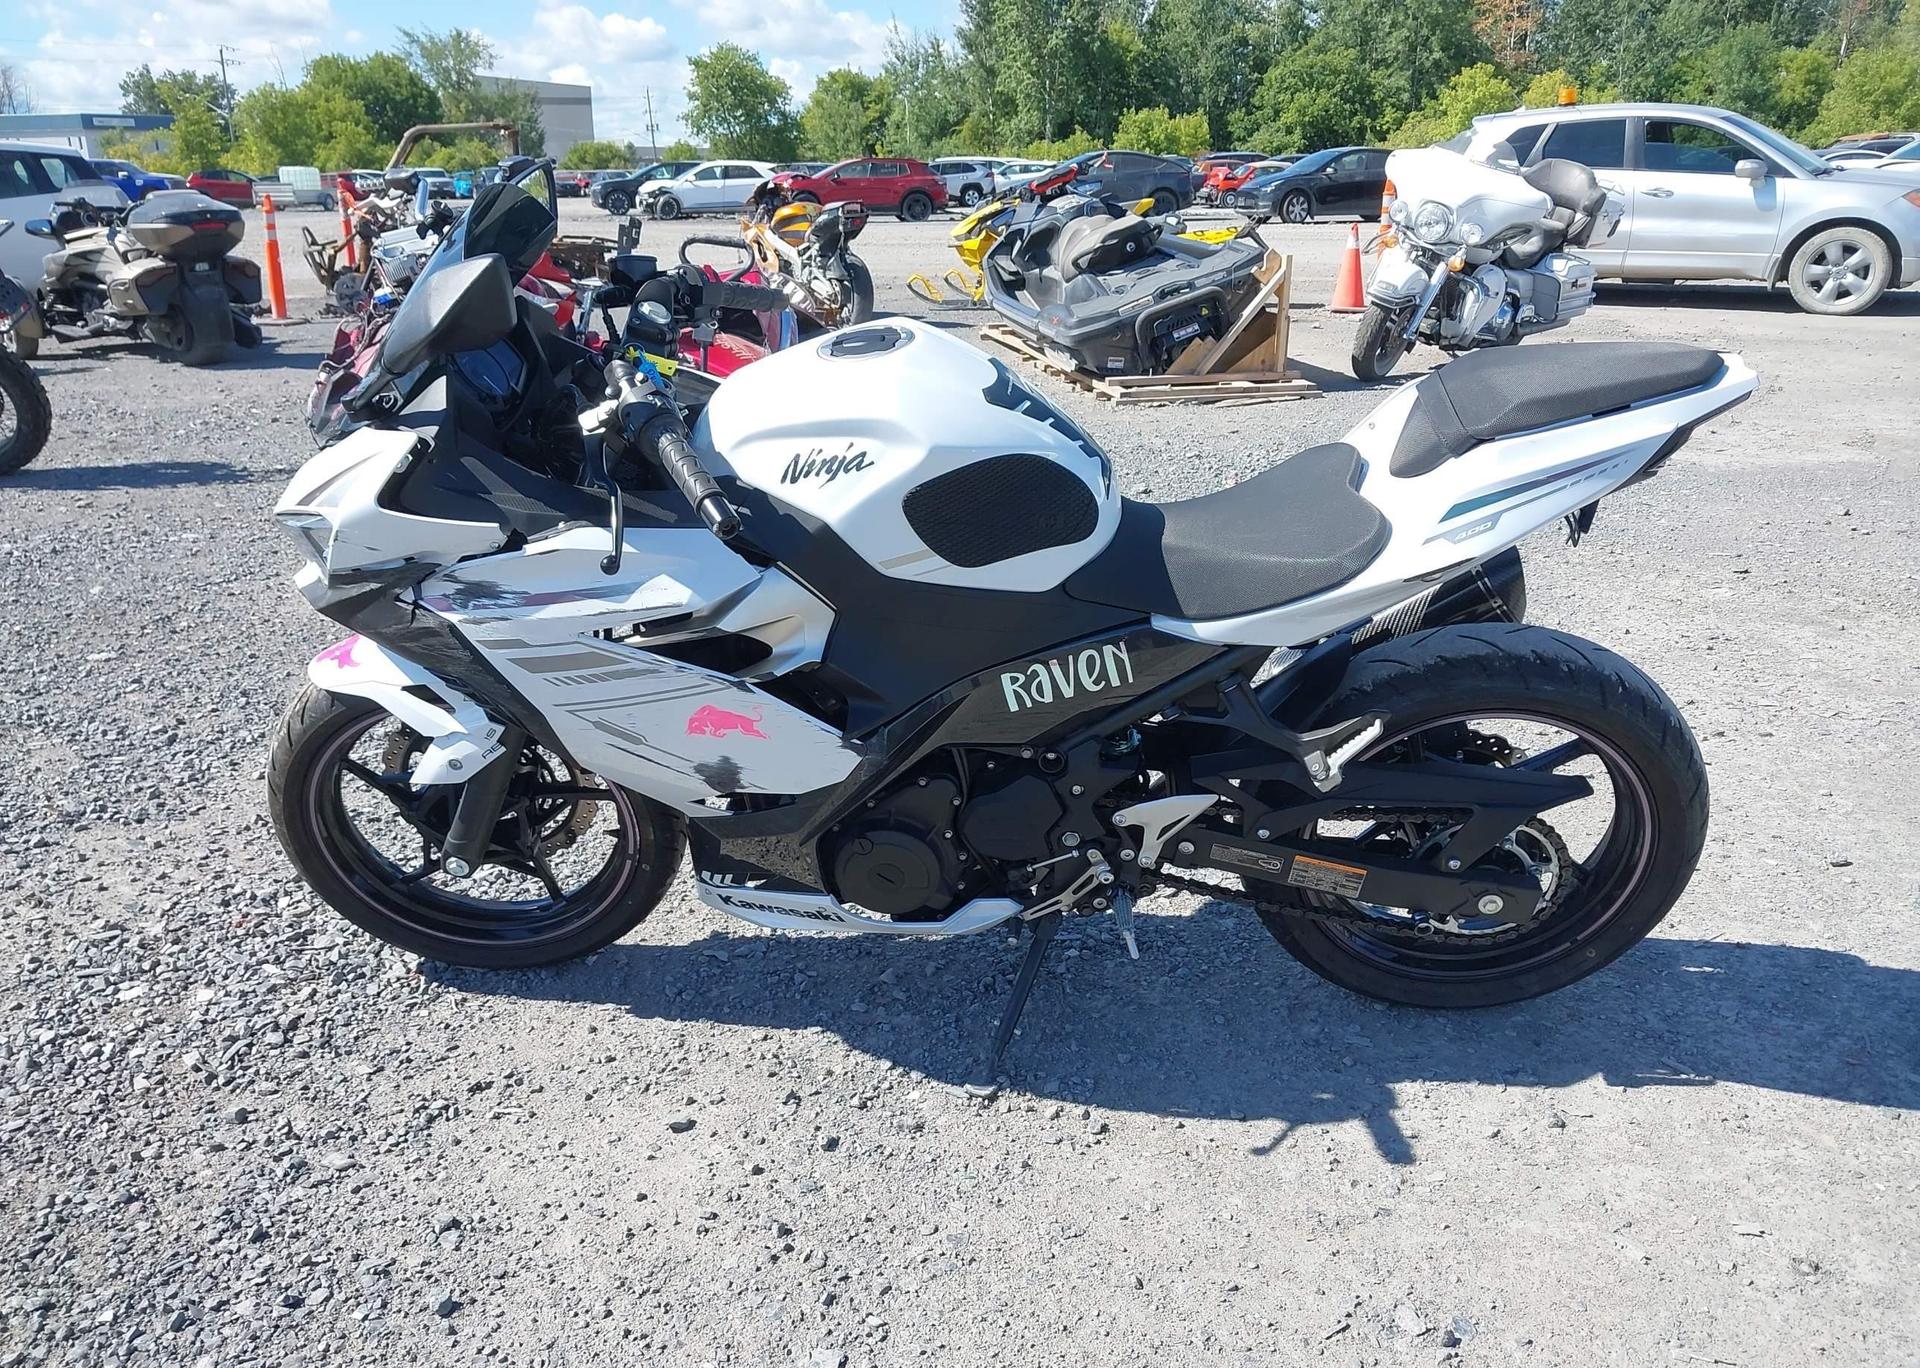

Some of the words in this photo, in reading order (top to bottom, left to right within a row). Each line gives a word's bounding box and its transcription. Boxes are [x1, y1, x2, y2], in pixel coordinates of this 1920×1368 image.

[780, 441, 875, 490] Ninja
[1455, 521, 1493, 540] 400
[716, 893, 847, 923] Kawasaki
